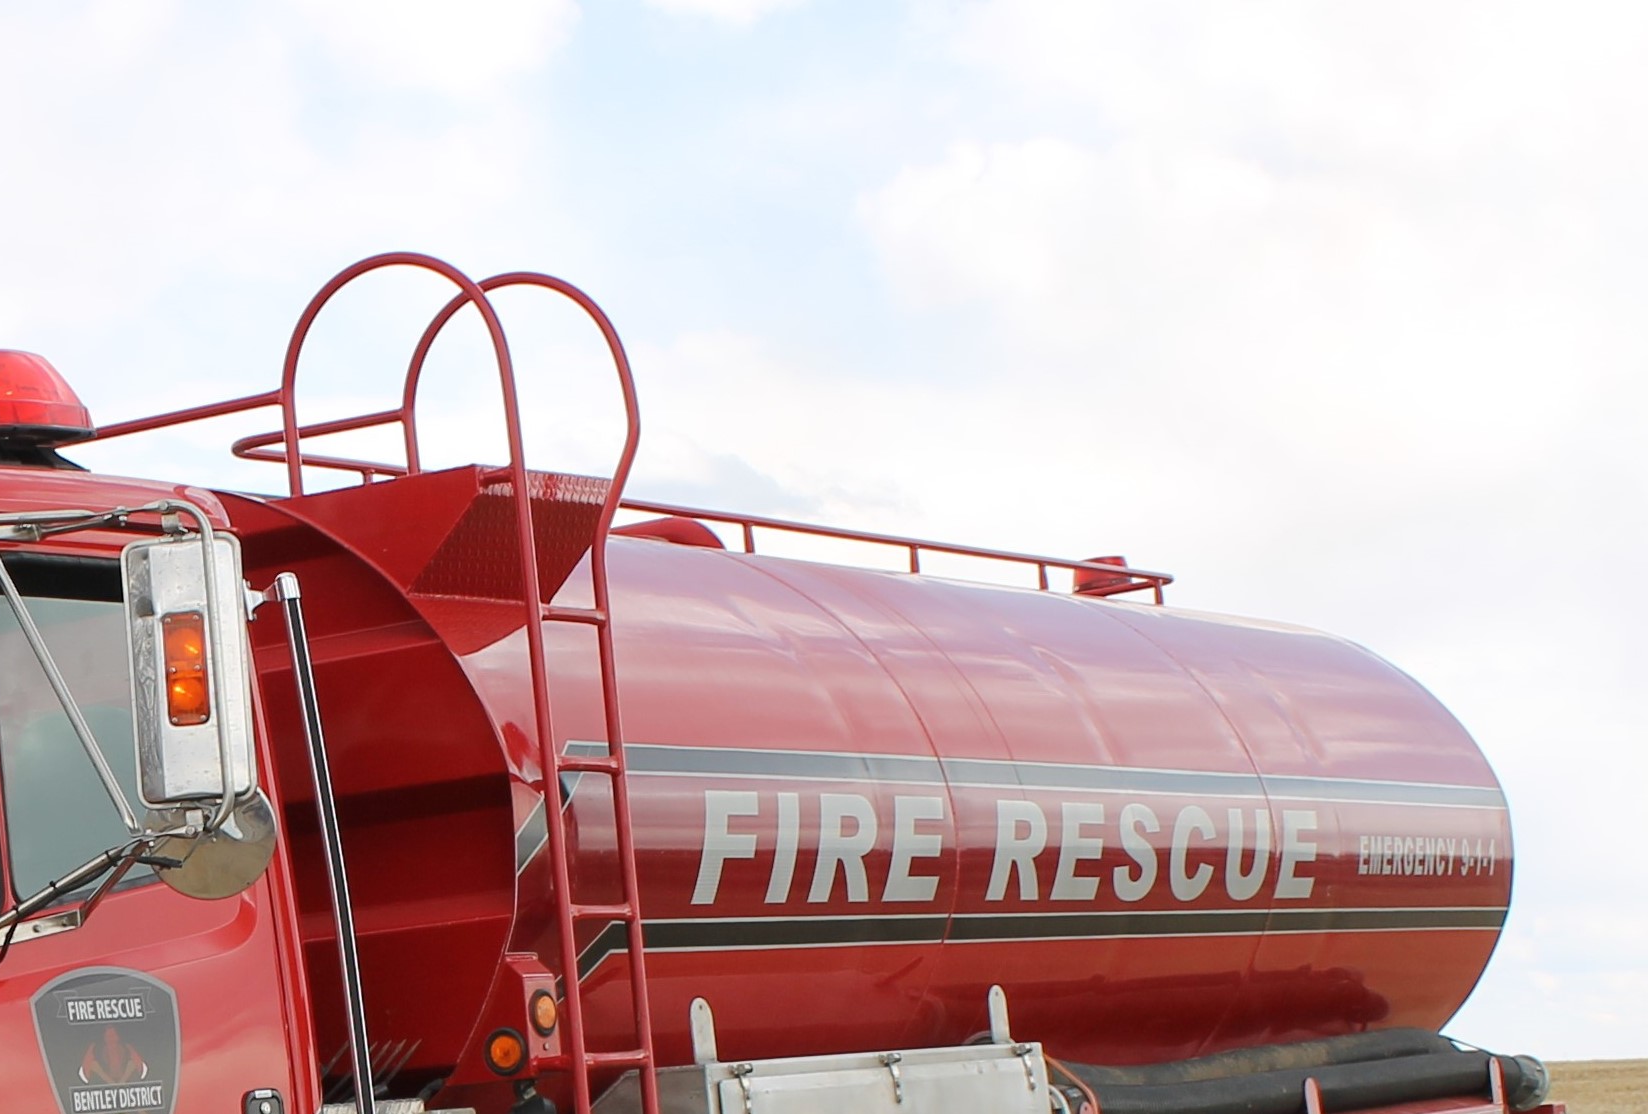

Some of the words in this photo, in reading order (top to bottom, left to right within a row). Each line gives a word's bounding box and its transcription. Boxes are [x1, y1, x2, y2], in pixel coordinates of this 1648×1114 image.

[690, 790, 944, 905] FIRE
[985, 799, 1318, 902] RESCUE
[1358, 835, 1456, 876] EMERGENCY
[1461, 838, 1495, 877] 9-1-1
[67, 1000, 96, 1021] FIRE
[96, 998, 143, 1019] RESCUE
[73, 1090, 120, 1112] BENTLEY
[119, 1085, 162, 1108] DISTRICT
